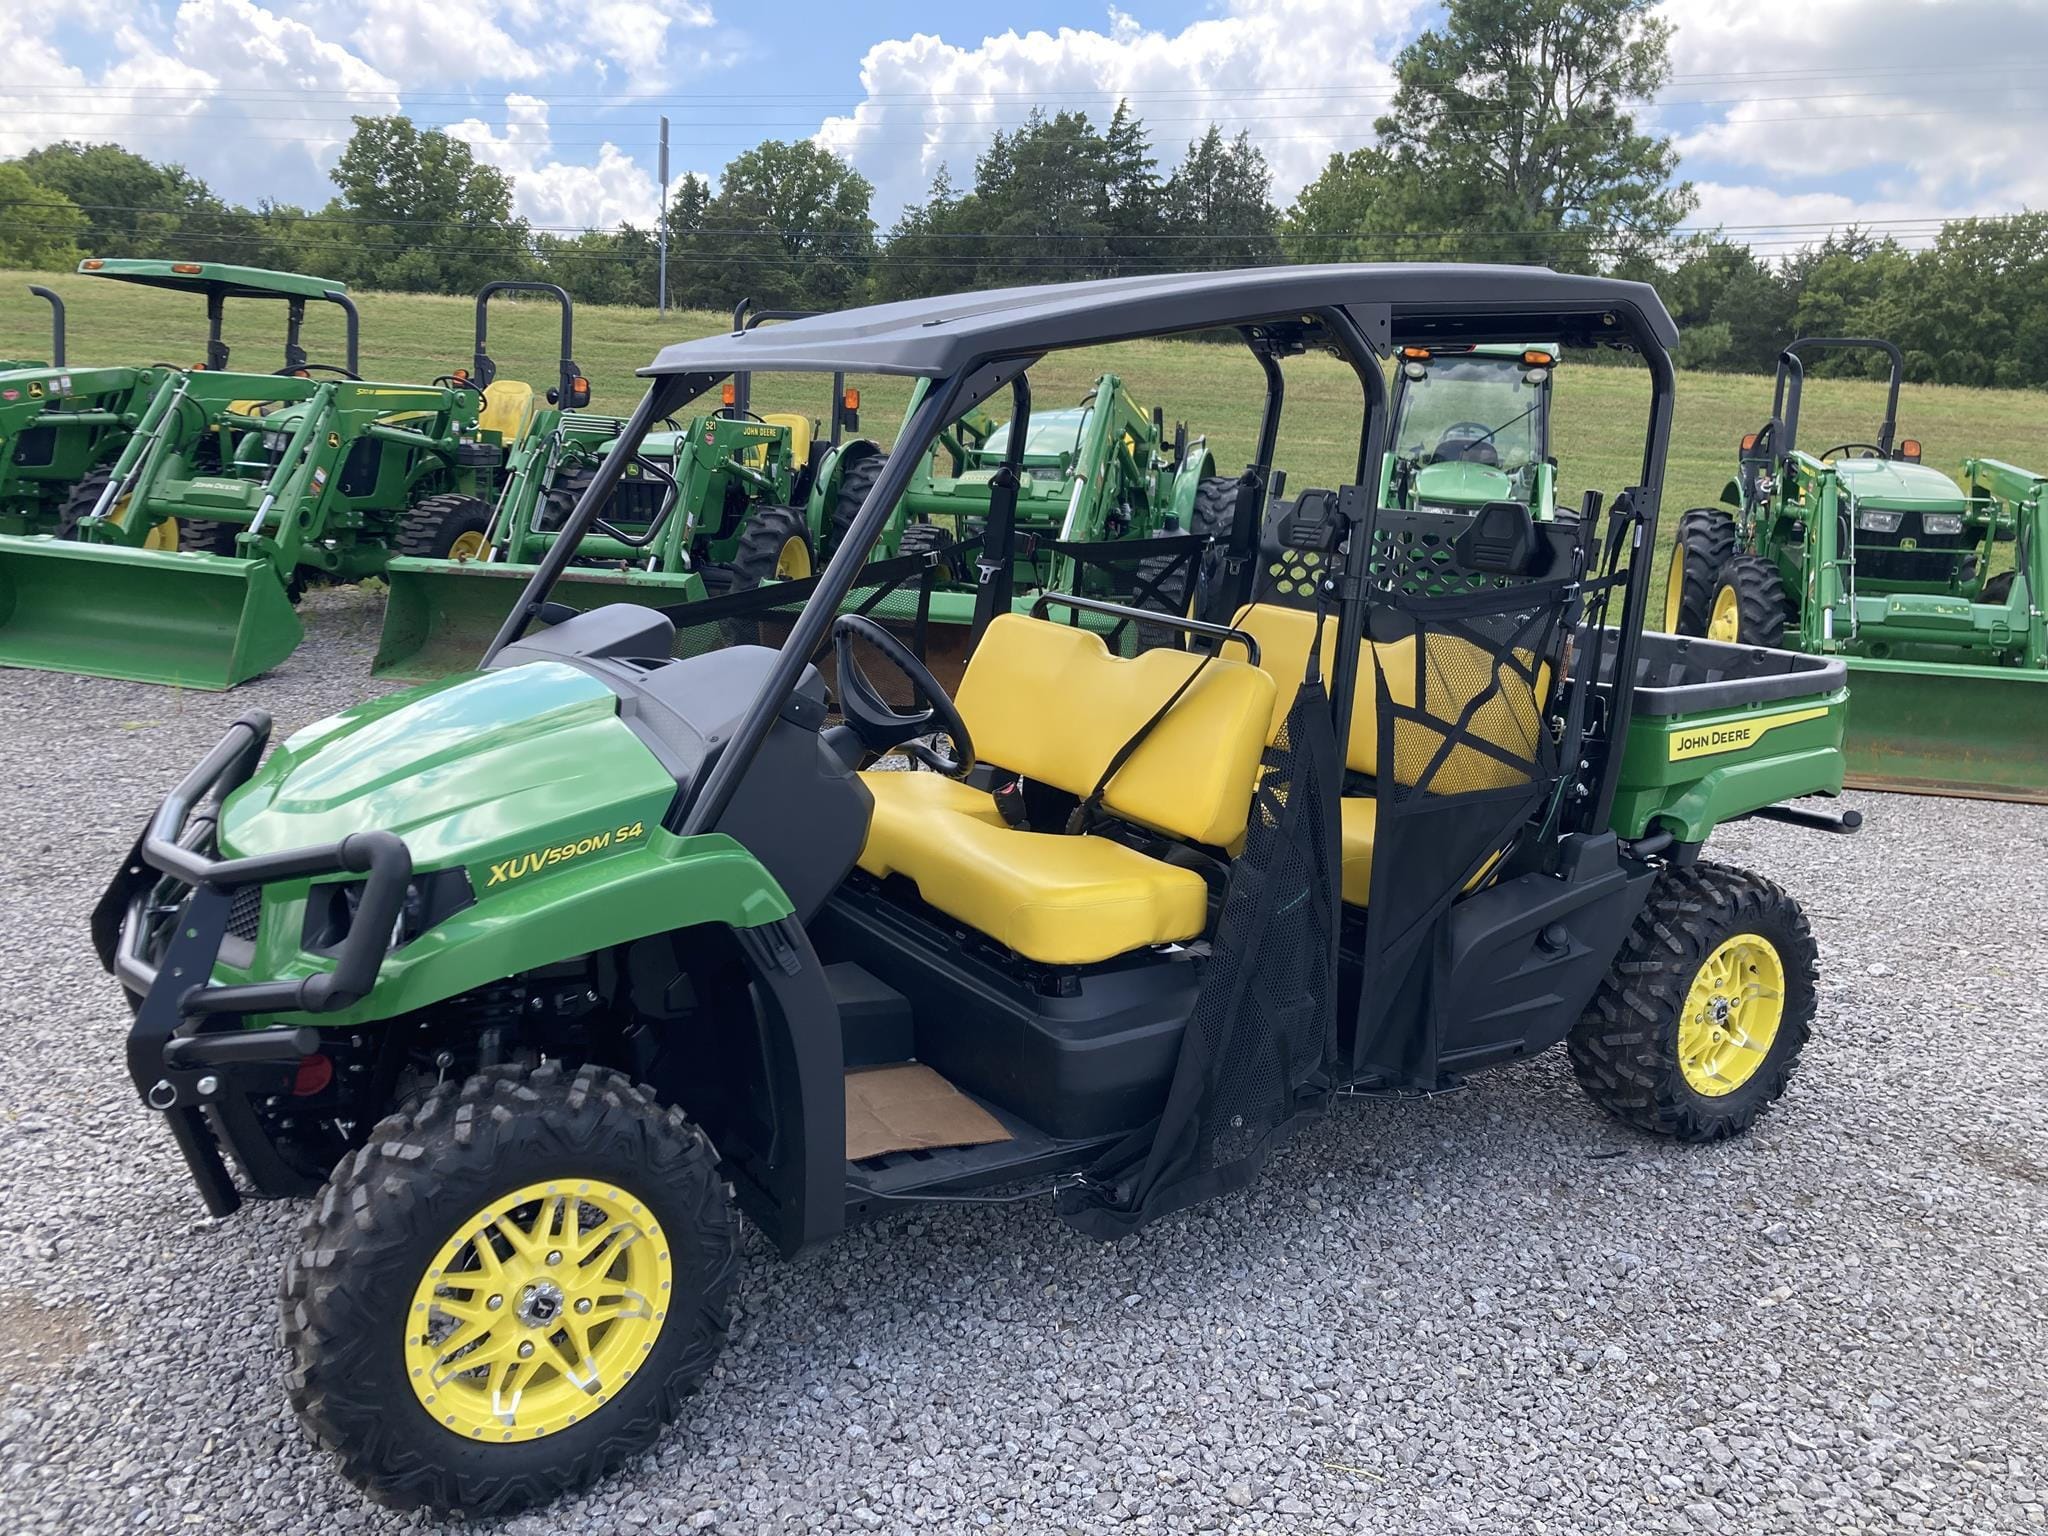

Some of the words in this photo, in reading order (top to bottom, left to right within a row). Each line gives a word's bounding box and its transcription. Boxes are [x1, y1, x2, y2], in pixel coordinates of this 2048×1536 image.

[705, 421, 716, 431] 521
[743, 427, 759, 437] JOHN
[760, 428, 777, 438] DEERE
[192, 481, 213, 489] JOHN
[214, 482, 242, 491] DEERE
[1677, 735, 1709, 752] JOHN
[1712, 728, 1751, 746] DEERE
[486, 832, 611, 888] XUV590M
[614, 821, 644, 844] S4
